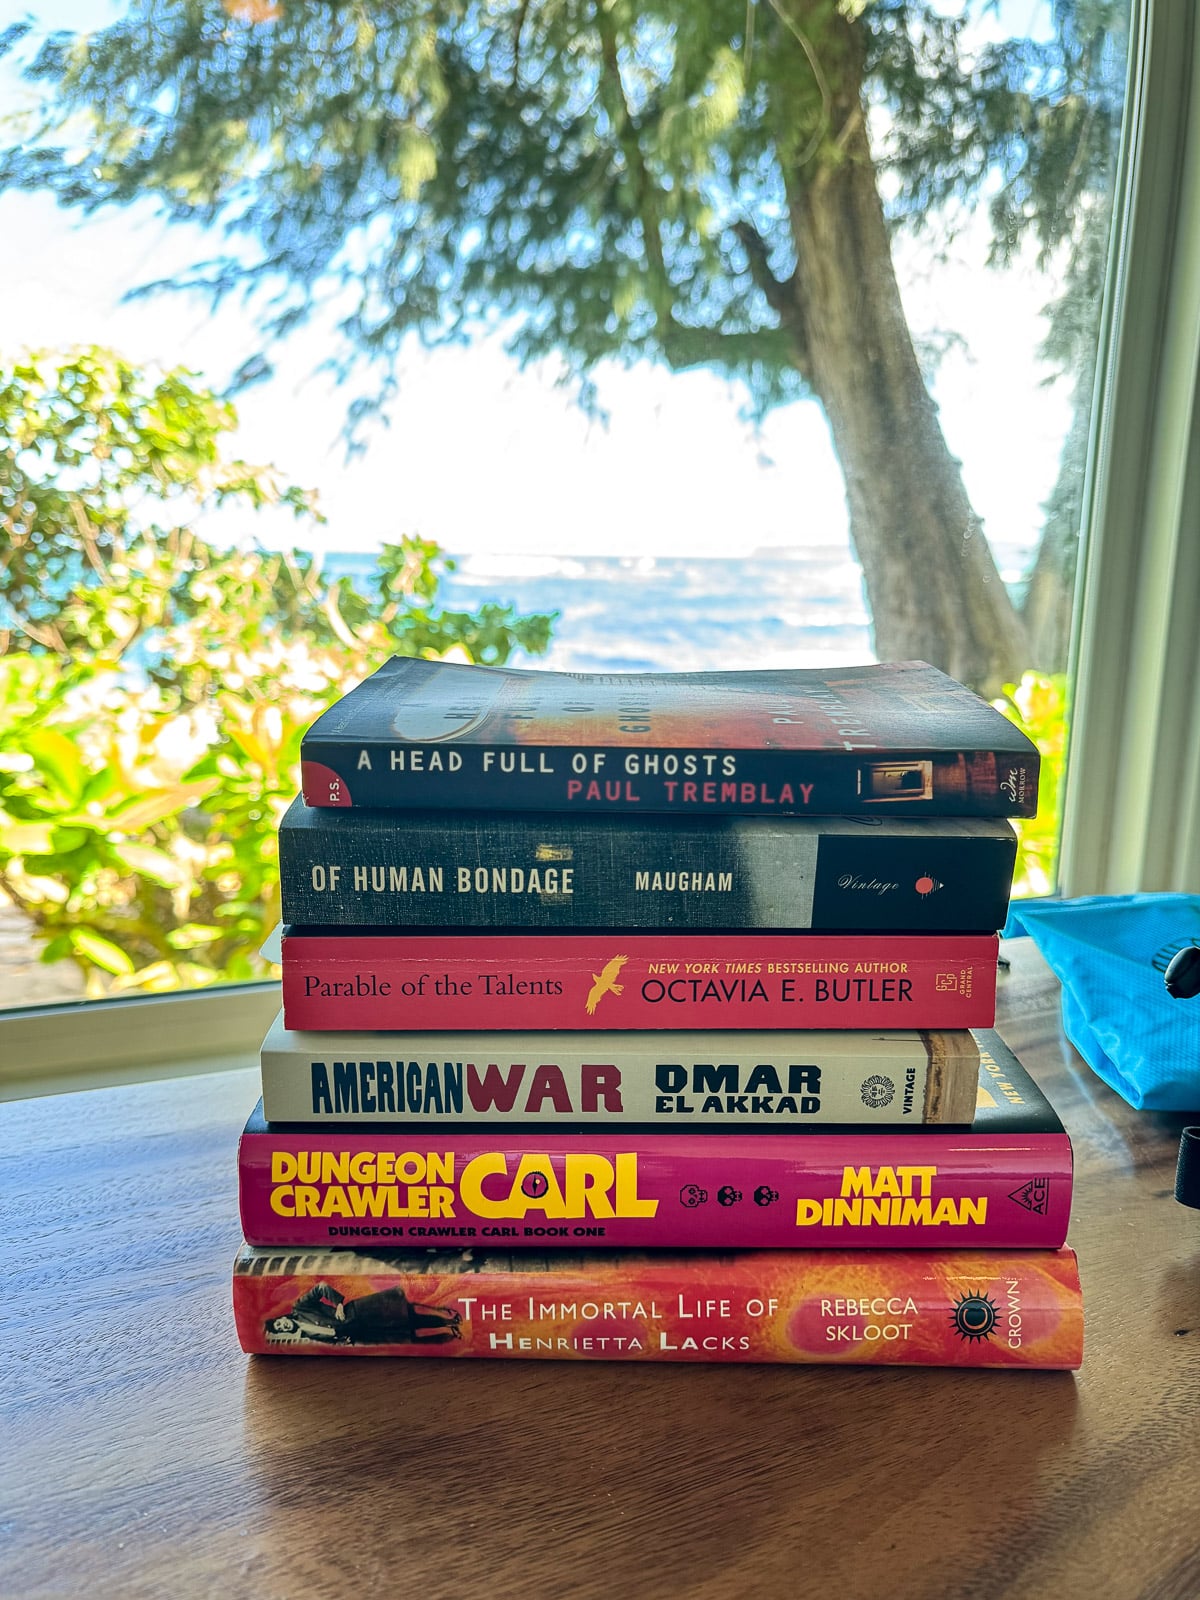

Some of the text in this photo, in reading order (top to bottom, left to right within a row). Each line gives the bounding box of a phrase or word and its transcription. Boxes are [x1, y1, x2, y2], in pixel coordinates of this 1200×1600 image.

[357, 750, 737, 776] A HEAD FULL OF GHOSTS
[329, 778, 340, 802] P.S.
[567, 780, 815, 804] PAUL TREMBLAY
[1018, 767, 1026, 804] MORROW
[311, 866, 575, 894] OF HUMAN BONDAGE
[635, 871, 734, 892] MAUGHAM
[837, 874, 899, 896] Vintage
[648, 963, 909, 974] NEW YORK TIMES BESTSELLING AUTHOR
[965, 965, 973, 999] CENTRAL
[304, 974, 564, 997] Parable of the Talents
[641, 978, 914, 1004] OCTAVIA E. BUTLER
[310, 1061, 625, 1114] AMERICAN WAR
[654, 1064, 822, 1094] OMAR
[902, 1067, 916, 1115] VINTAGE
[655, 1095, 822, 1115] EL AKKAD
[995, 1081, 1026, 1105] NEW
[270, 1151, 456, 1185] DUNGEON
[840, 1165, 938, 1198] MATT
[459, 1151, 660, 1220] CARL
[1032, 1177, 1047, 1215] ACE
[269, 1185, 457, 1219] CRAWLER
[796, 1196, 988, 1227] DINNIMAN
[328, 1226, 606, 1237] DUNGEON CRAWLER CARL BOOK ONE
[458, 1293, 780, 1321] THE IMMORTAL LIFE OF
[820, 1297, 919, 1317] REBECCA
[1007, 1280, 1021, 1349] CROWN
[489, 1331, 751, 1351] HENRIETTA LACKS
[825, 1323, 913, 1342] SKLOOT
